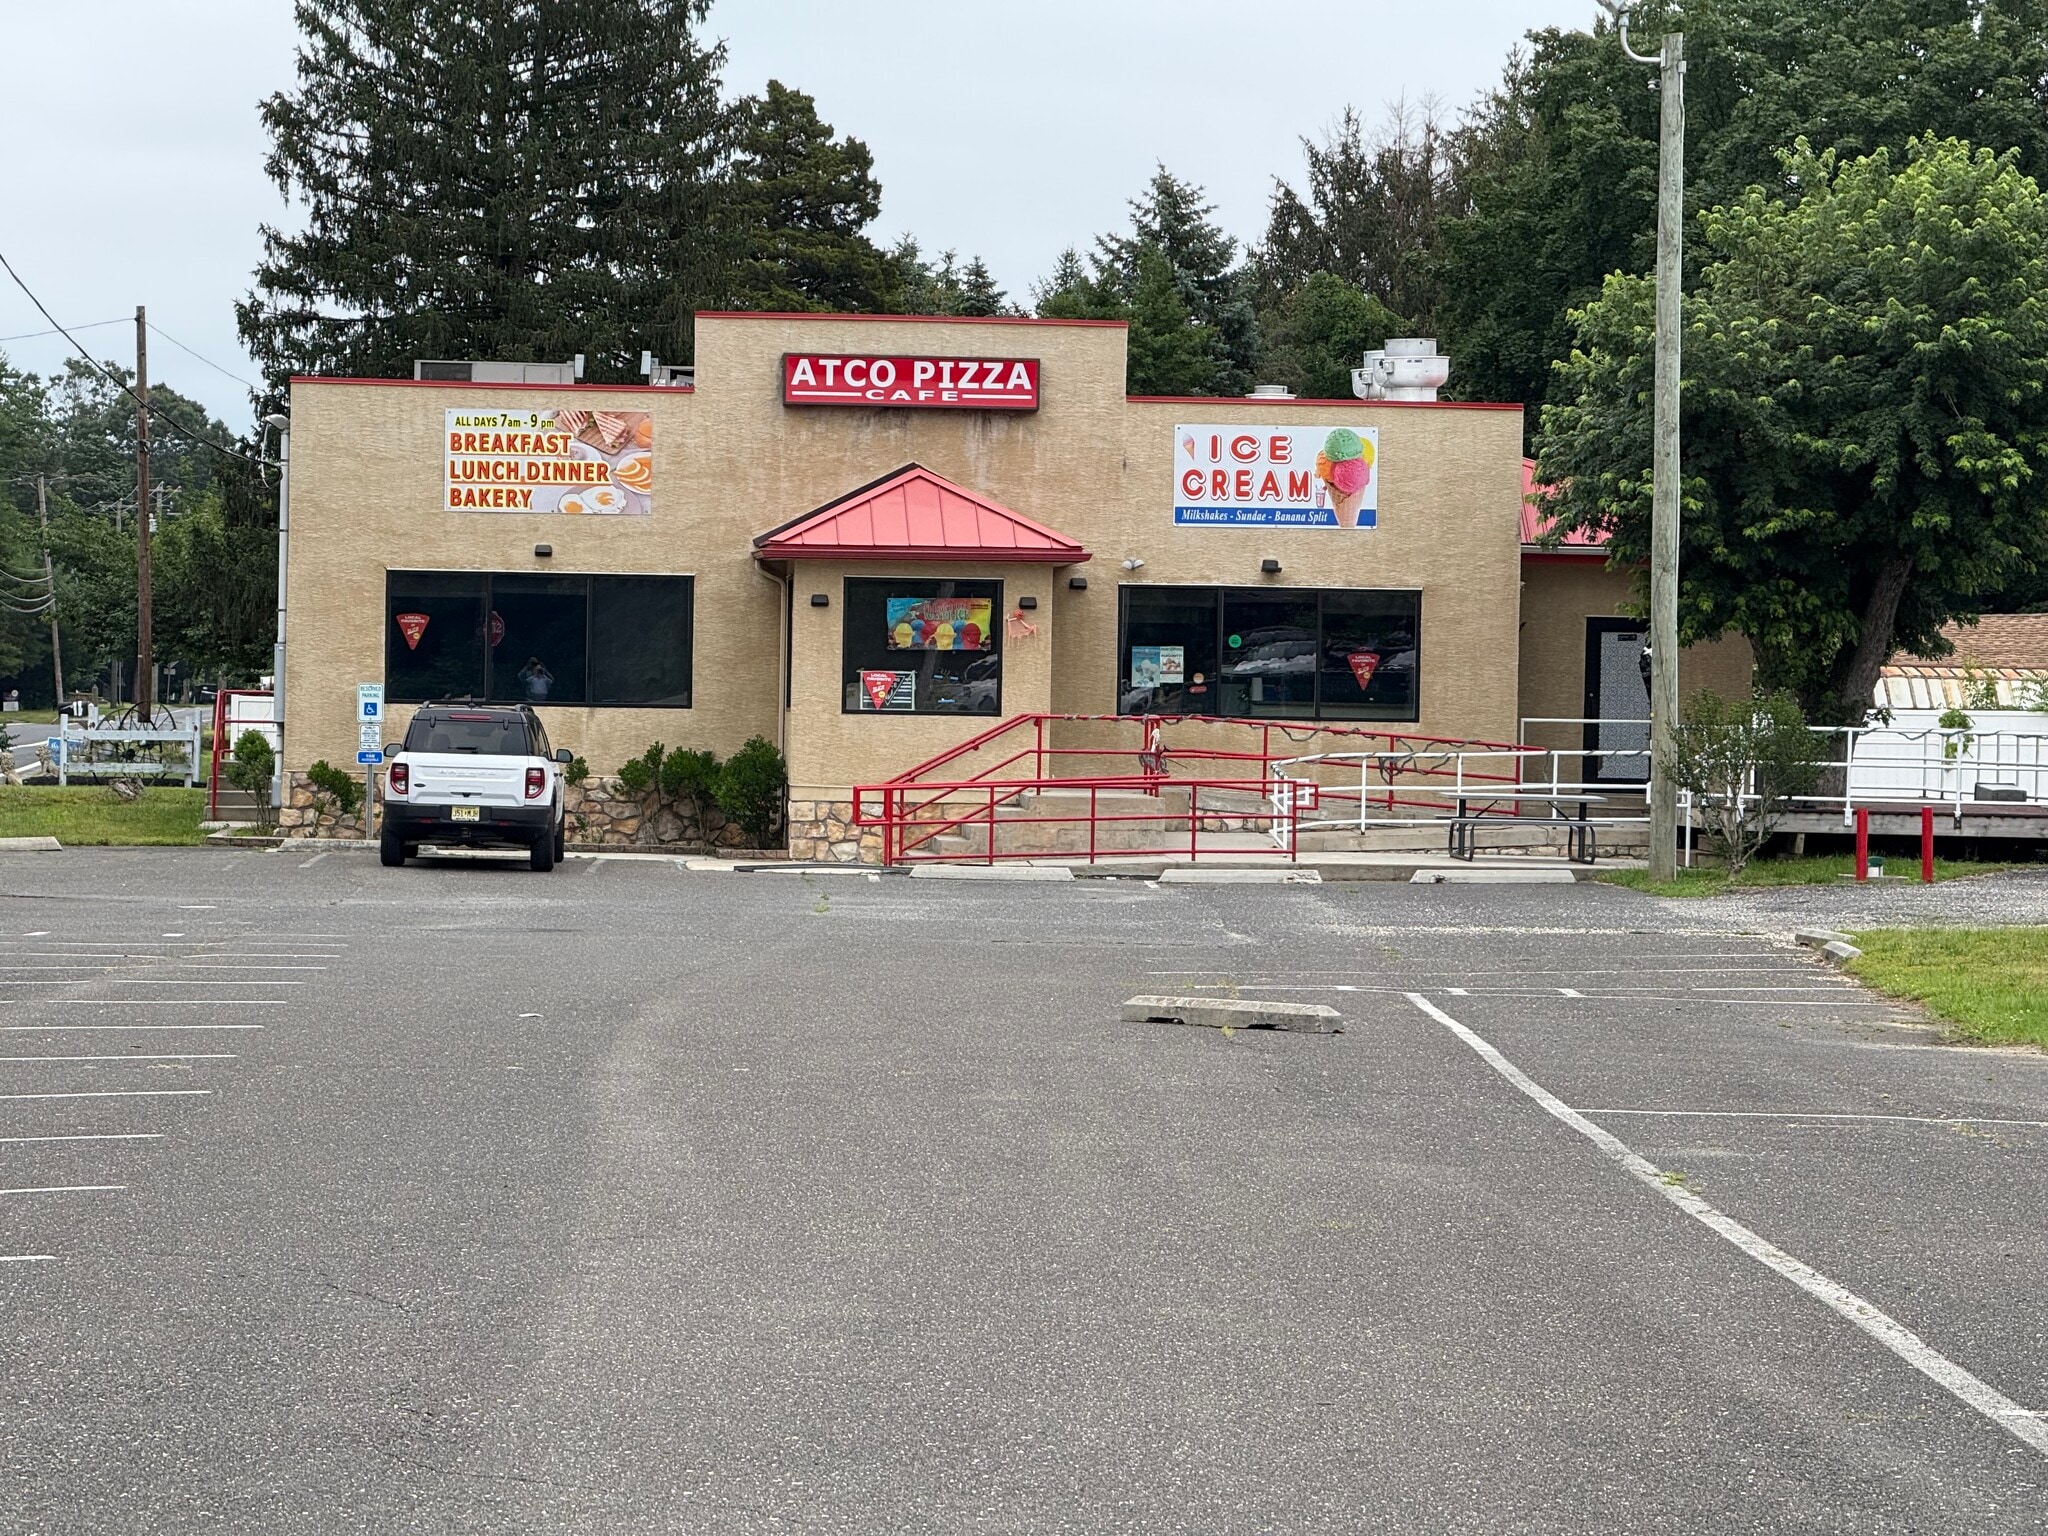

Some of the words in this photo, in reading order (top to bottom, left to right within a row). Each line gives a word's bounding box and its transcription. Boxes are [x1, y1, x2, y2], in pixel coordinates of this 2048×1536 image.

[791, 358, 896, 388] ATCO
[913, 360, 1032, 390] PIZZA
[865, 389, 959, 402] CAFE
[455, 416, 471, 427] ALL
[474, 416, 497, 427] DAYS
[500, 413, 521, 427] 7am
[530, 413, 538, 428] 9
[541, 418, 554, 430] pm
[450, 432, 572, 454] BREAKFAST
[1208, 433, 1292, 465] ICE
[450, 460, 520, 480] LUNCH
[527, 461, 610, 482] DINNER
[1181, 468, 1313, 502] CREAM
[450, 487, 533, 508] BAKERY
[1181, 509, 1228, 521] Milkshakes
[1235, 510, 1266, 522] Sundae
[1274, 511, 1306, 522] Banana
[1307, 511, 1328, 524] Split
